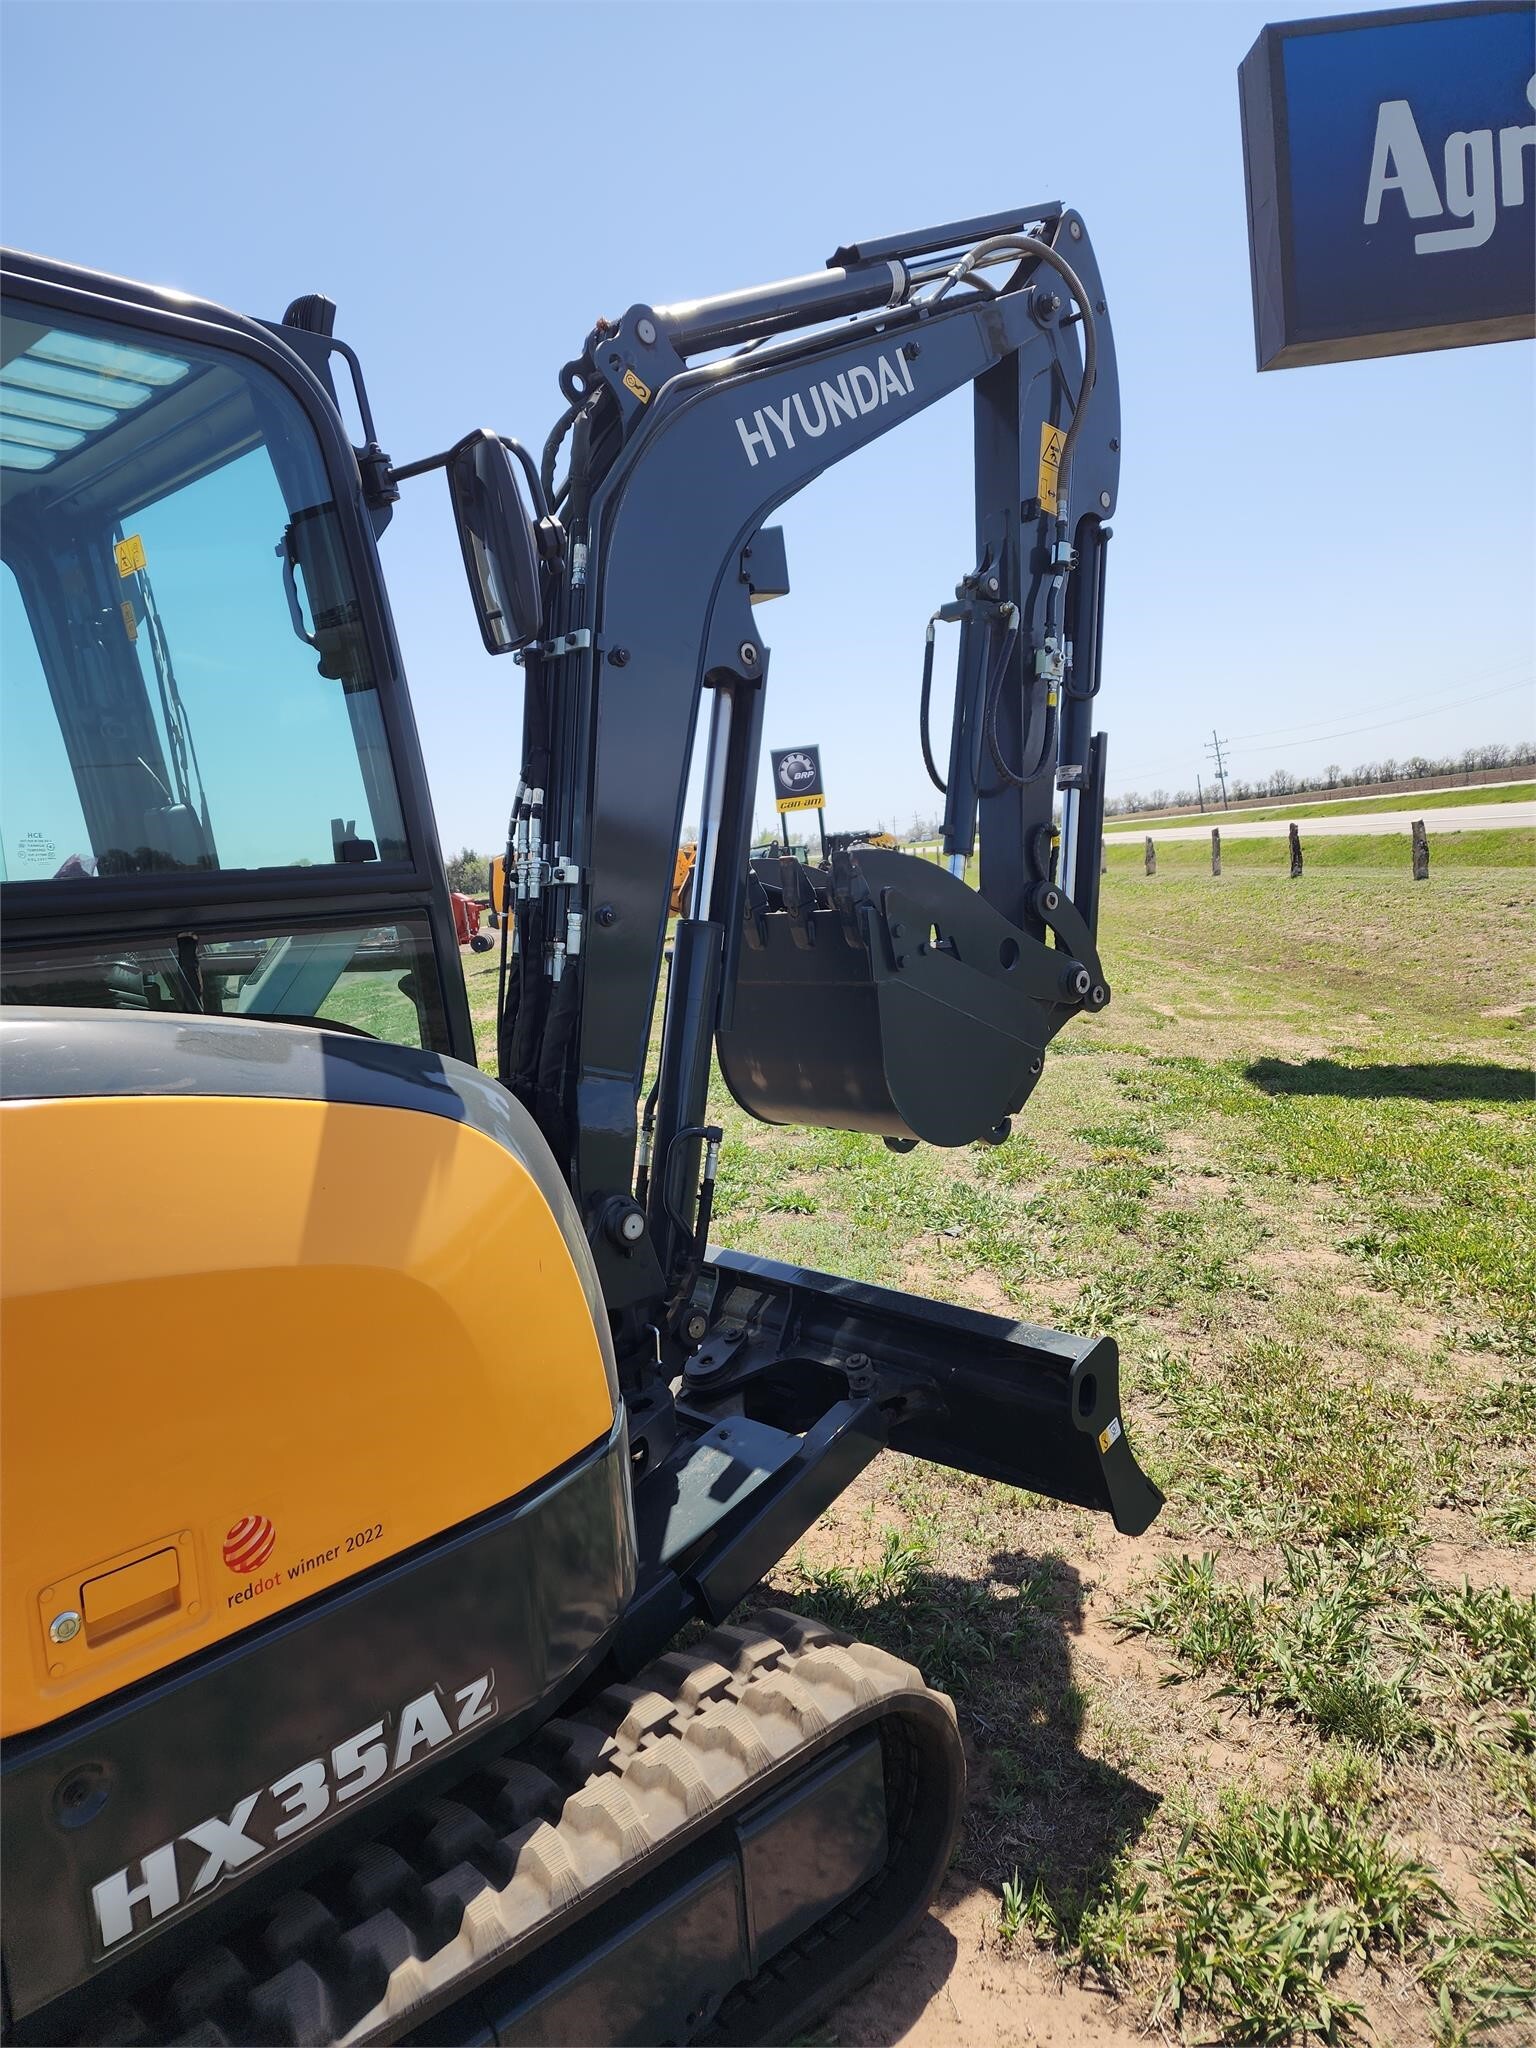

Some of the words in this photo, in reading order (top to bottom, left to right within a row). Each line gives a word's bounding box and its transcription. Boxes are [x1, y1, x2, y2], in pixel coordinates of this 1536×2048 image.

[735, 347, 915, 466] HYUNDAI
[794, 770, 815, 780] BRP
[227, 1572, 281, 1608] reddot
[287, 1546, 340, 1580] winner
[345, 1523, 384, 1553] 2022
